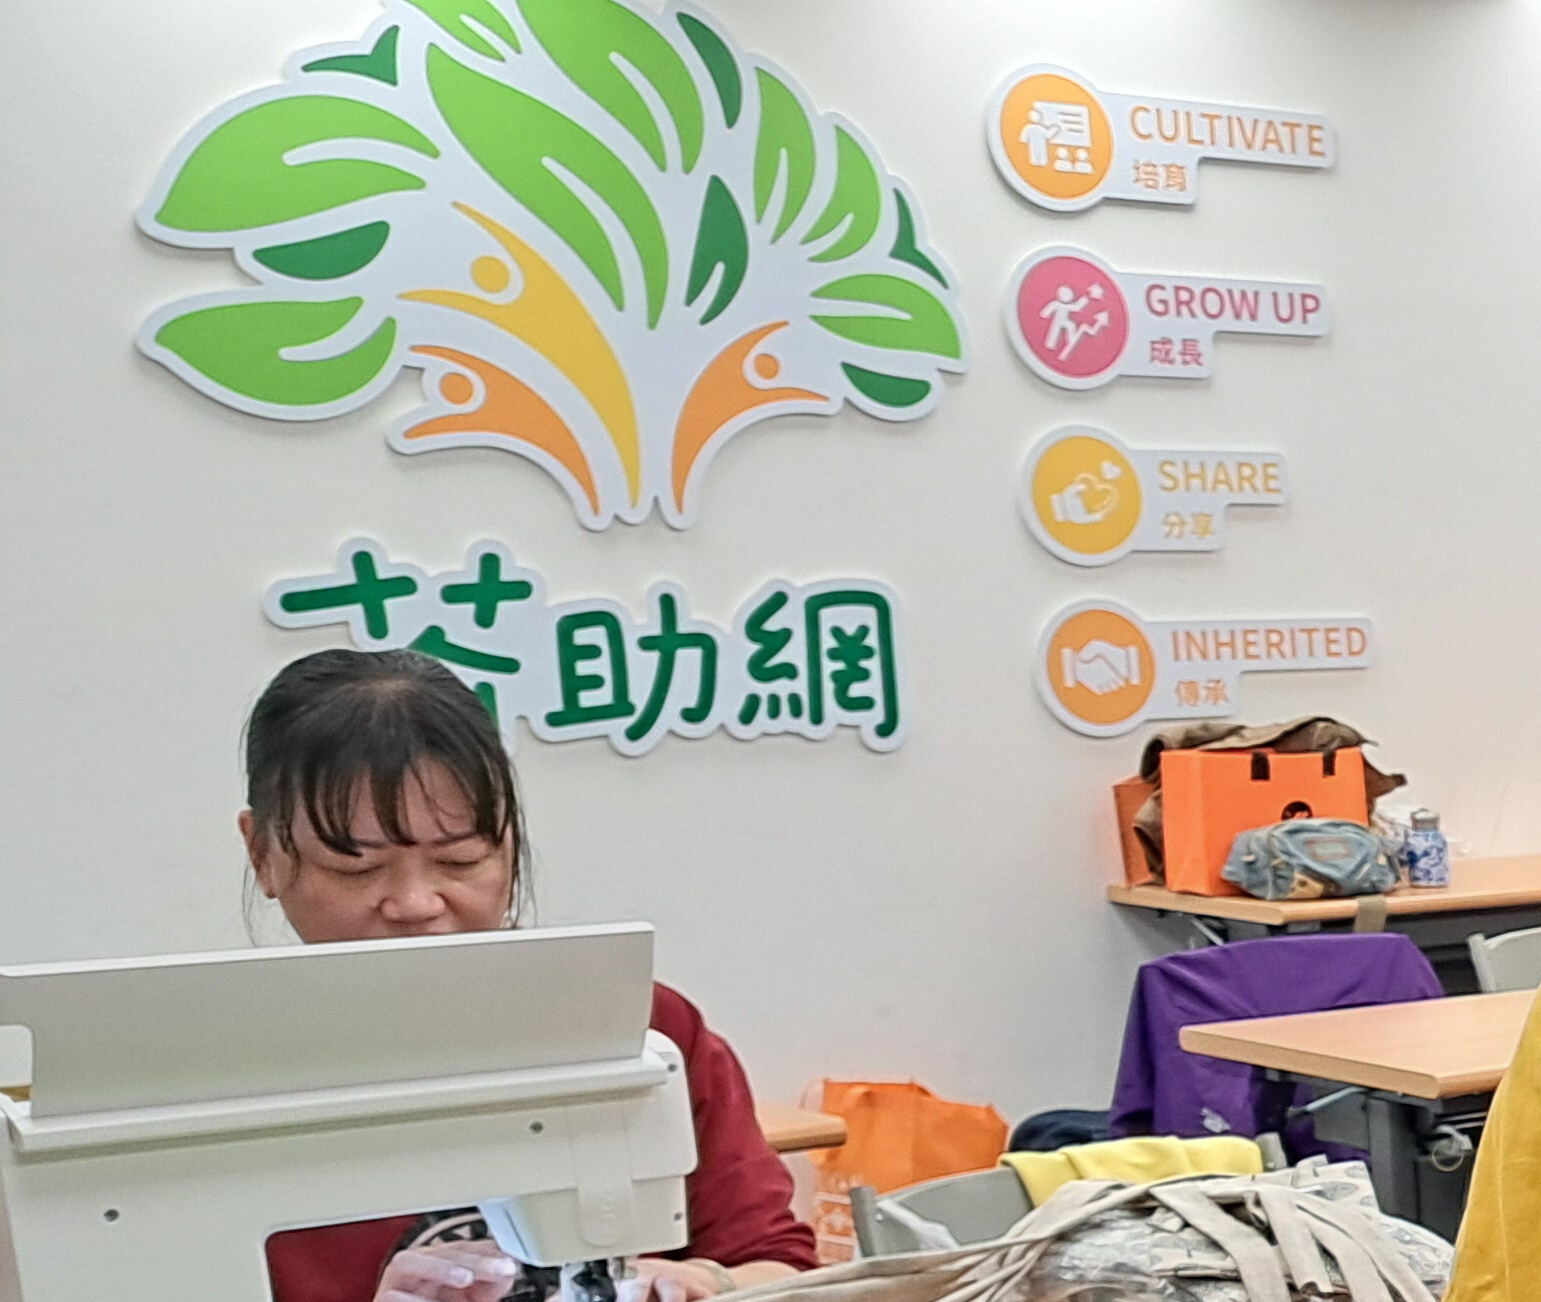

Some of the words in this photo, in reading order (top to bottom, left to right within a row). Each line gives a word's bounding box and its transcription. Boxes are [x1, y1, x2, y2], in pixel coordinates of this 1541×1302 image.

[1129, 105, 1325, 157] CULTIVATE
[1133, 161, 1188, 191] 培育
[1145, 283, 1260, 322] GROW
[1271, 291, 1322, 325] UP
[1150, 337, 1204, 367] 成長
[1157, 459, 1282, 495] SHARE
[1161, 511, 1216, 540] 分享
[1171, 626, 1369, 662] INHERITED
[1174, 678, 1229, 707] 傳承
